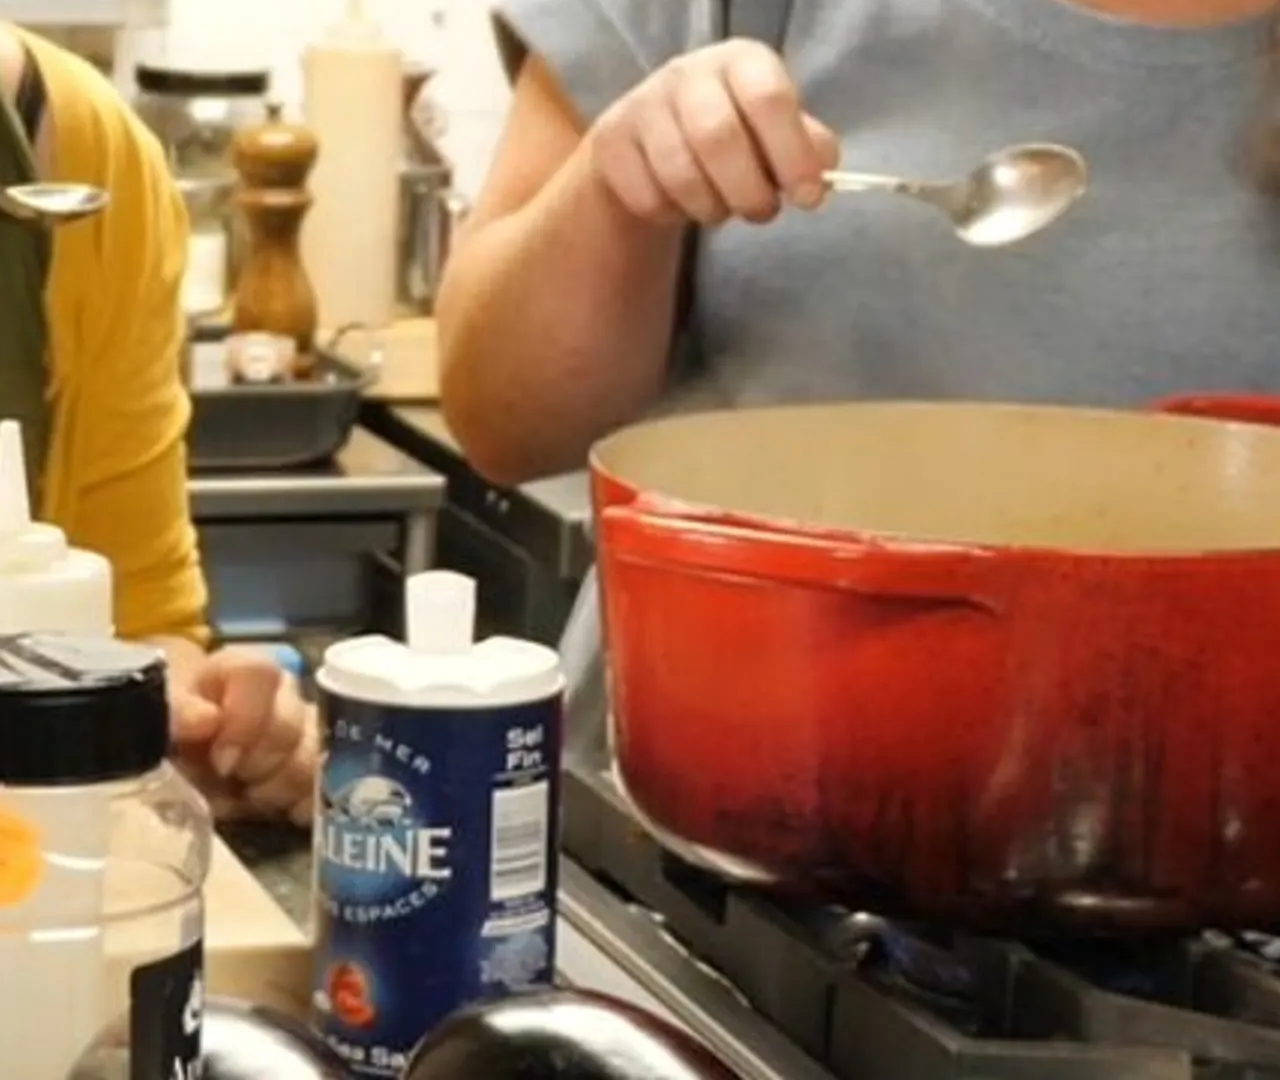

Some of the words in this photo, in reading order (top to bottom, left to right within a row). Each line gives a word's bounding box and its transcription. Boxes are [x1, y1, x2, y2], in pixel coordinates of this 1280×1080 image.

[374, 732, 432, 776] MER
[505, 723, 545, 749] Sel
[343, 881, 439, 924] ESPACES
